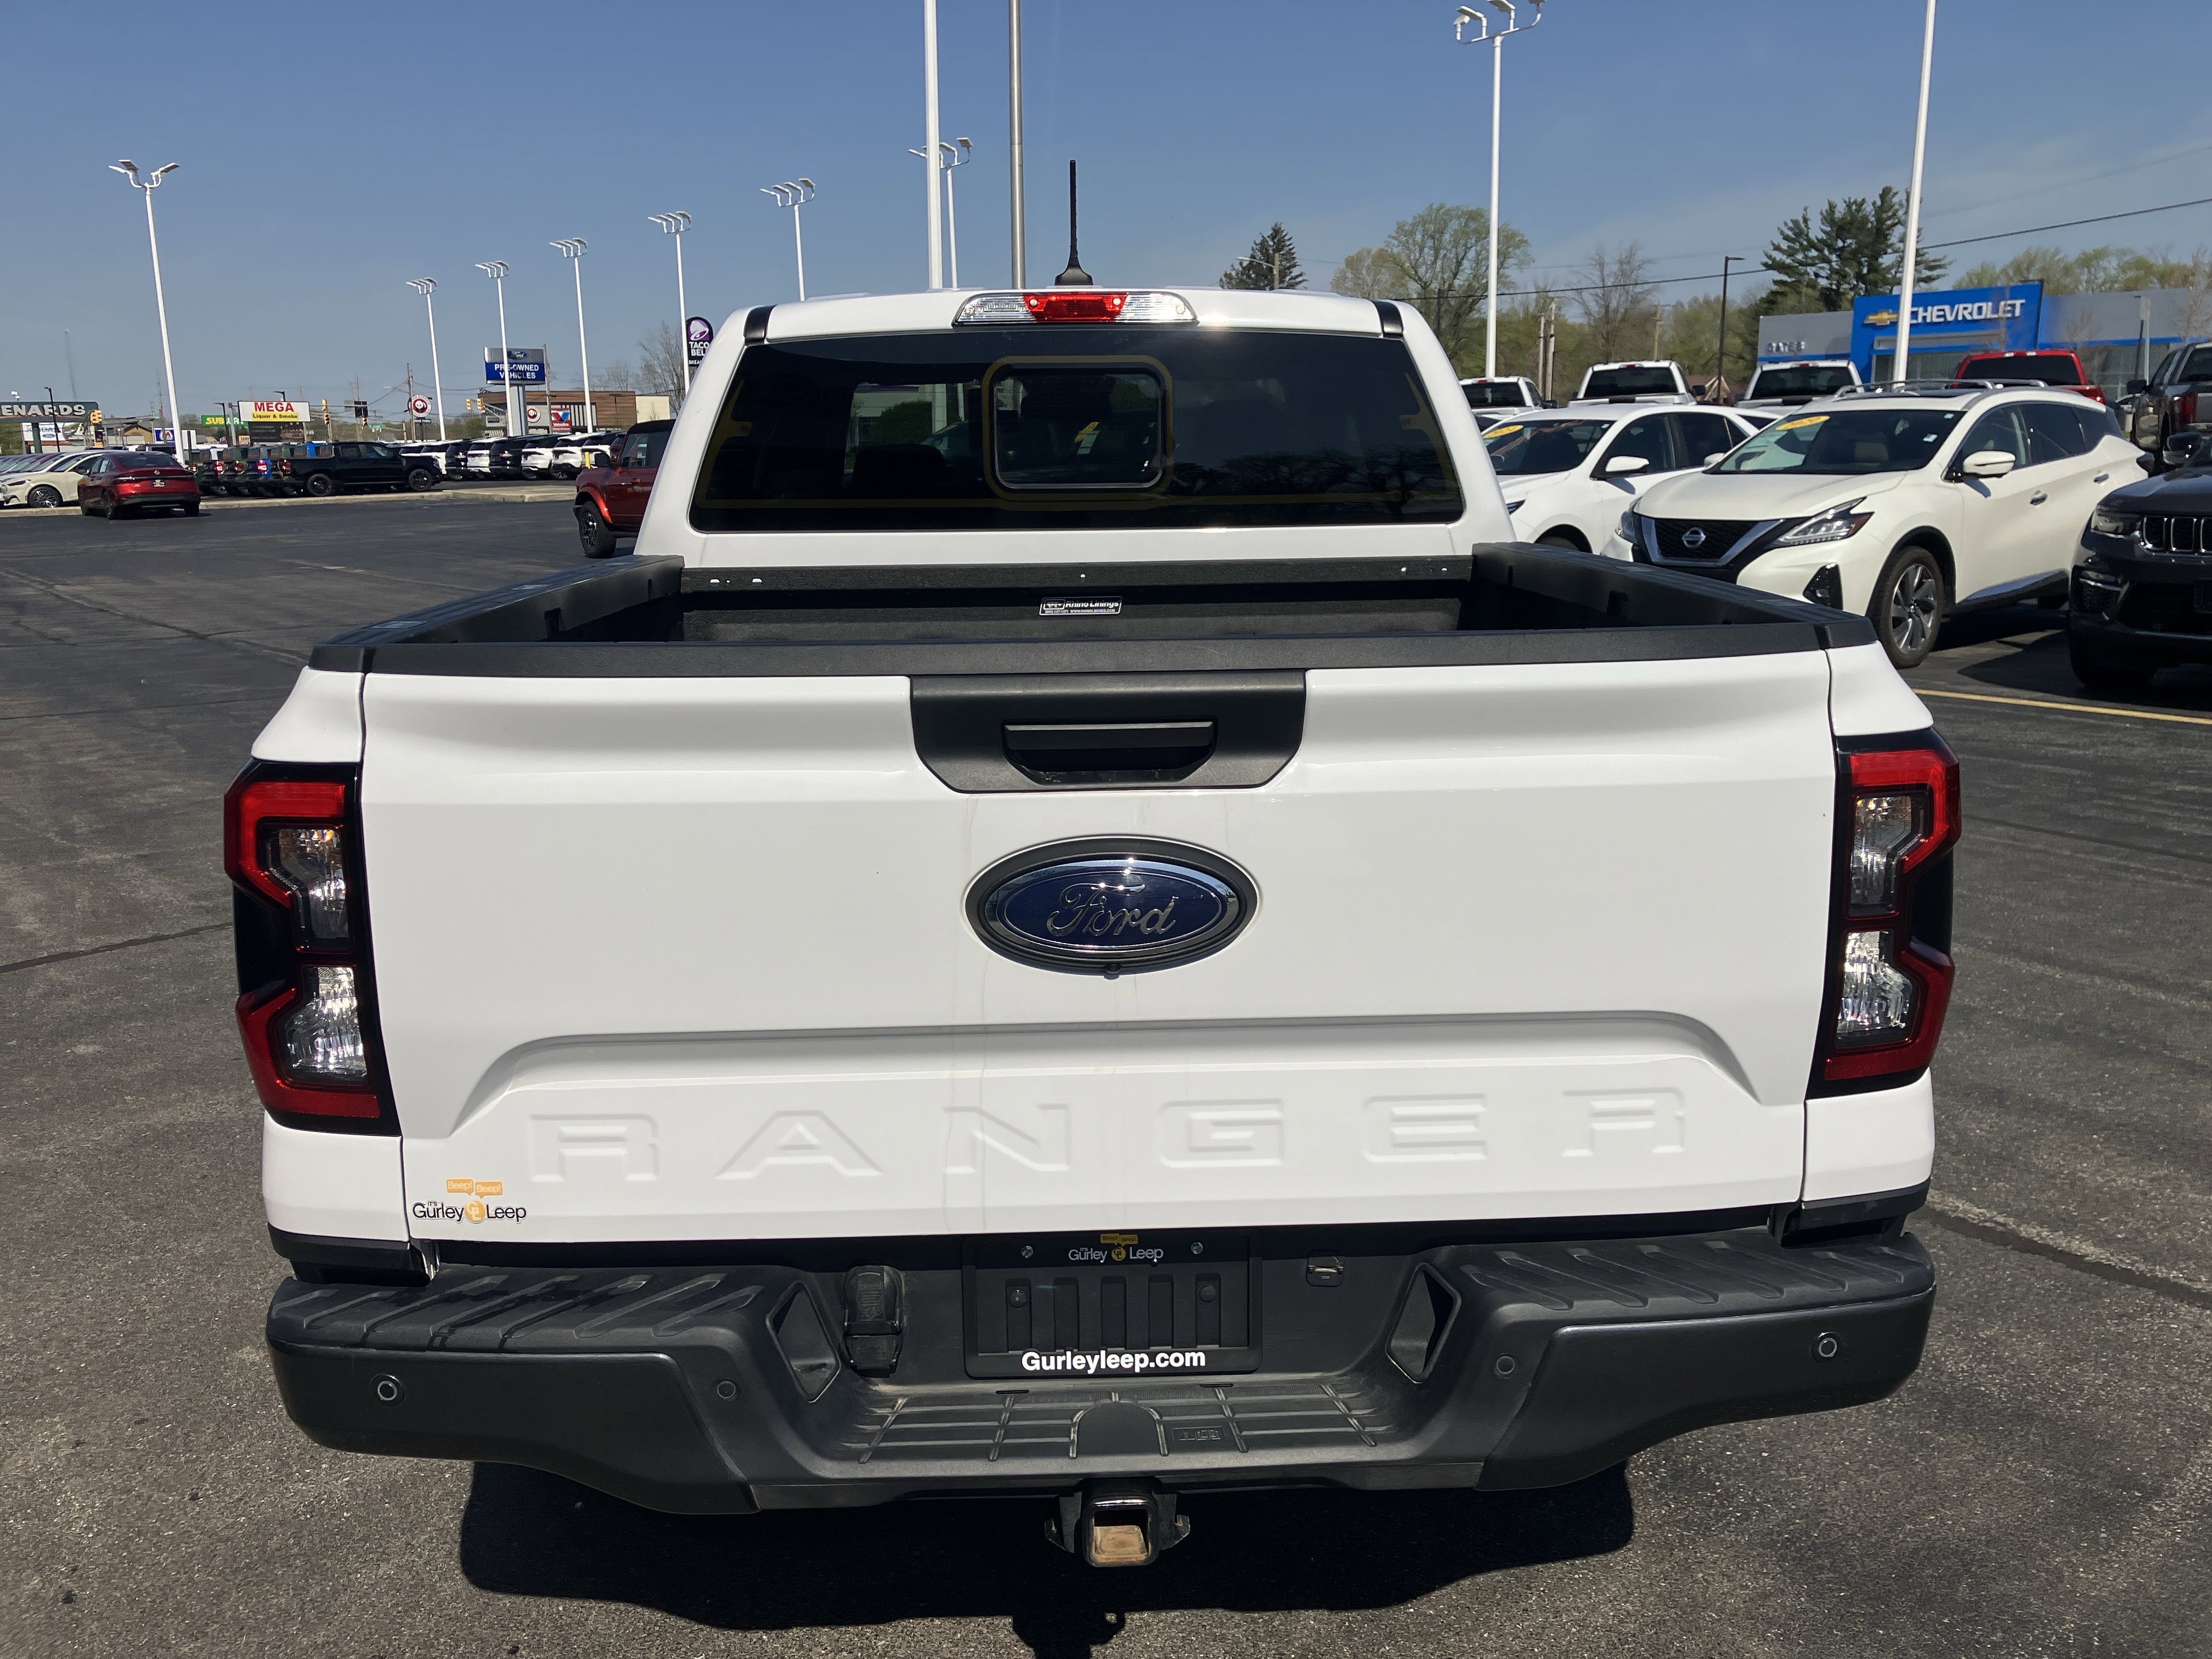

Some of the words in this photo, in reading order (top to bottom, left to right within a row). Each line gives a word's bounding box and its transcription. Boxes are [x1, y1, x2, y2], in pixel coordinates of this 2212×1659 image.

[1910, 299, 2025, 324] CHEVROLET
[0, 404, 86, 416] ENARDS
[254, 402, 295, 412] MEGA
[1090, 600, 1119, 608] Linings
[1046, 882, 1179, 936] Ford
[529, 1087, 1686, 1182] RANGER
[448, 1181, 473, 1192] Beep!
[476, 1183, 501, 1194] Beep!
[413, 1202, 464, 1222] Gurley
[486, 1204, 527, 1222] Leep
[1068, 1248, 1108, 1263] Gurley
[1129, 1246, 1164, 1262] Leep
[1021, 1351, 1206, 1374] Gurleyleep.com
